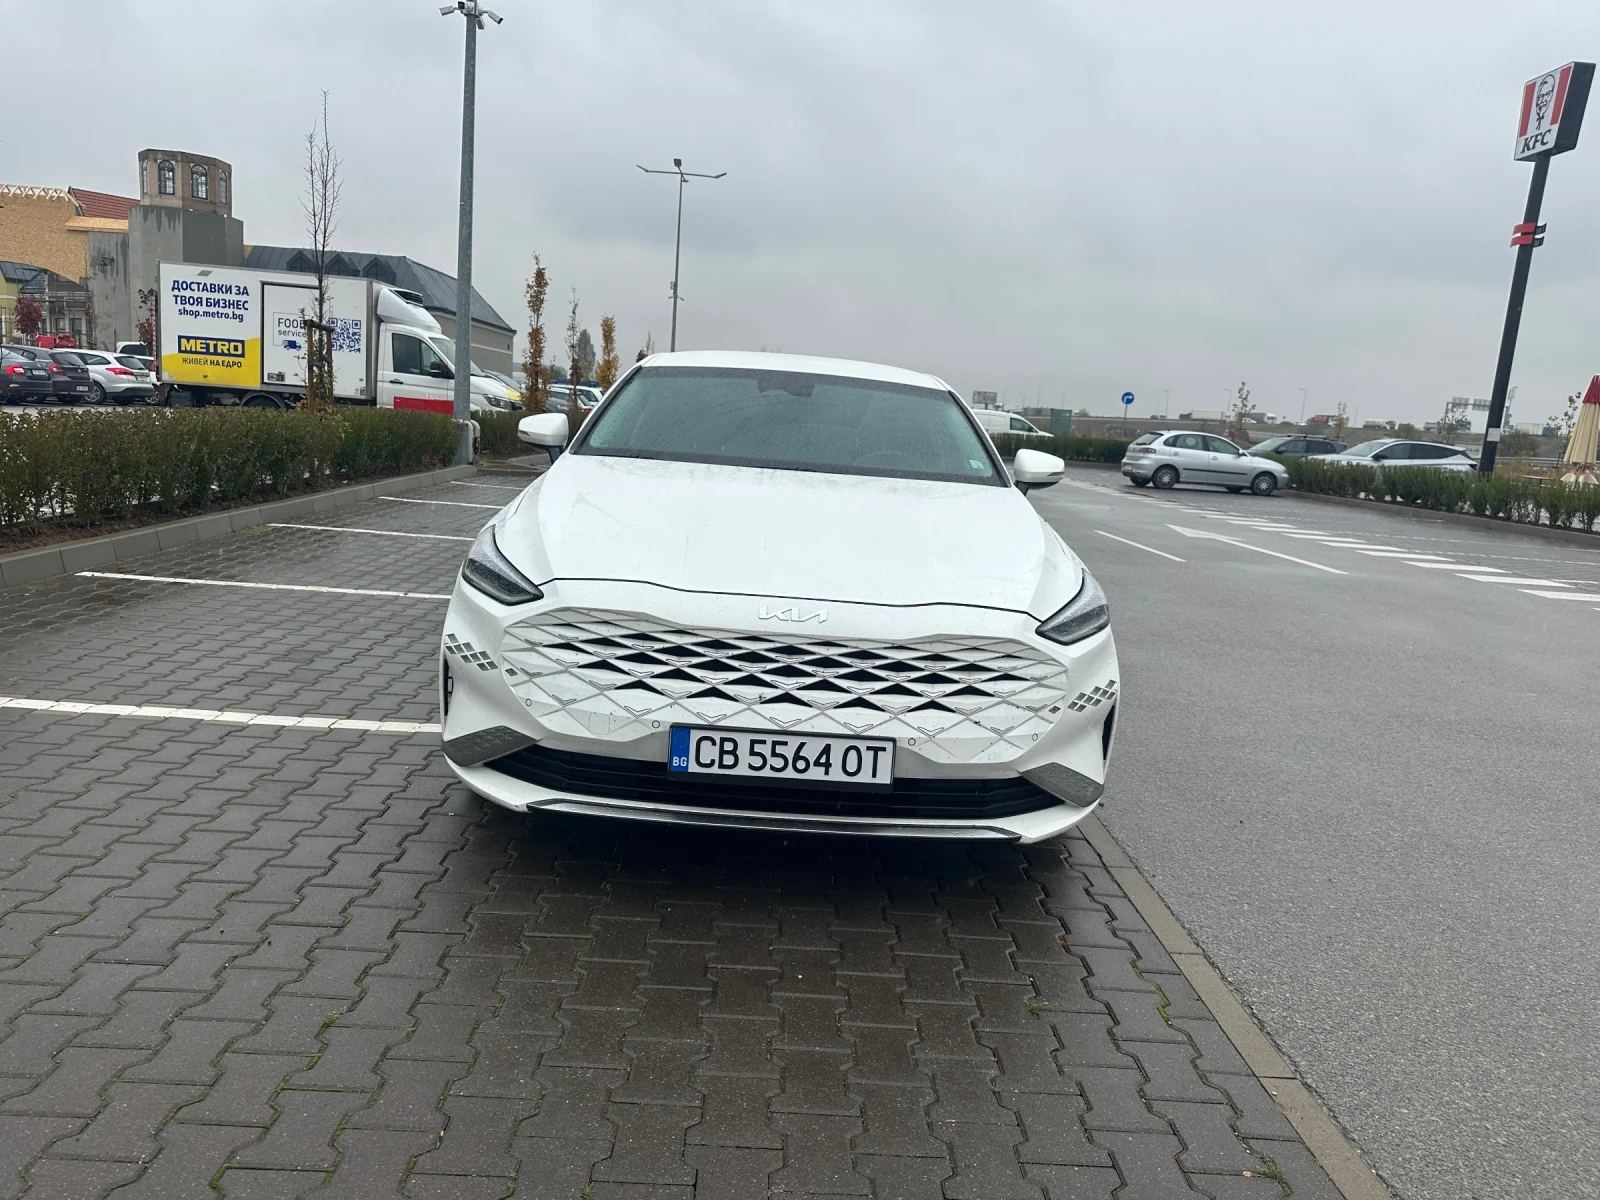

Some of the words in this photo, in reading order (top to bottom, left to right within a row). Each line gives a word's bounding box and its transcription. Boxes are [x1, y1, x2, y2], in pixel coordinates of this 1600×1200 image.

[1520, 128, 1552, 154] KFC
[171, 280, 232, 295] ДОСТАВКИ
[234, 285, 250, 297] ЗА
[172, 294, 203, 307] ТВОЯ
[205, 297, 249, 311] БИЗНЕС
[178, 306, 244, 323] shop.metro.bg
[277, 329, 307, 338] service
[180, 338, 243, 355] METRO
[181, 356, 208, 367] ЖИВЕЙ
[210, 359, 220, 367] НА
[221, 360, 242, 369] ЕДРО
[672, 756, 688, 767] BG
[694, 735, 740, 770] CB
[747, 738, 833, 776] 5564
